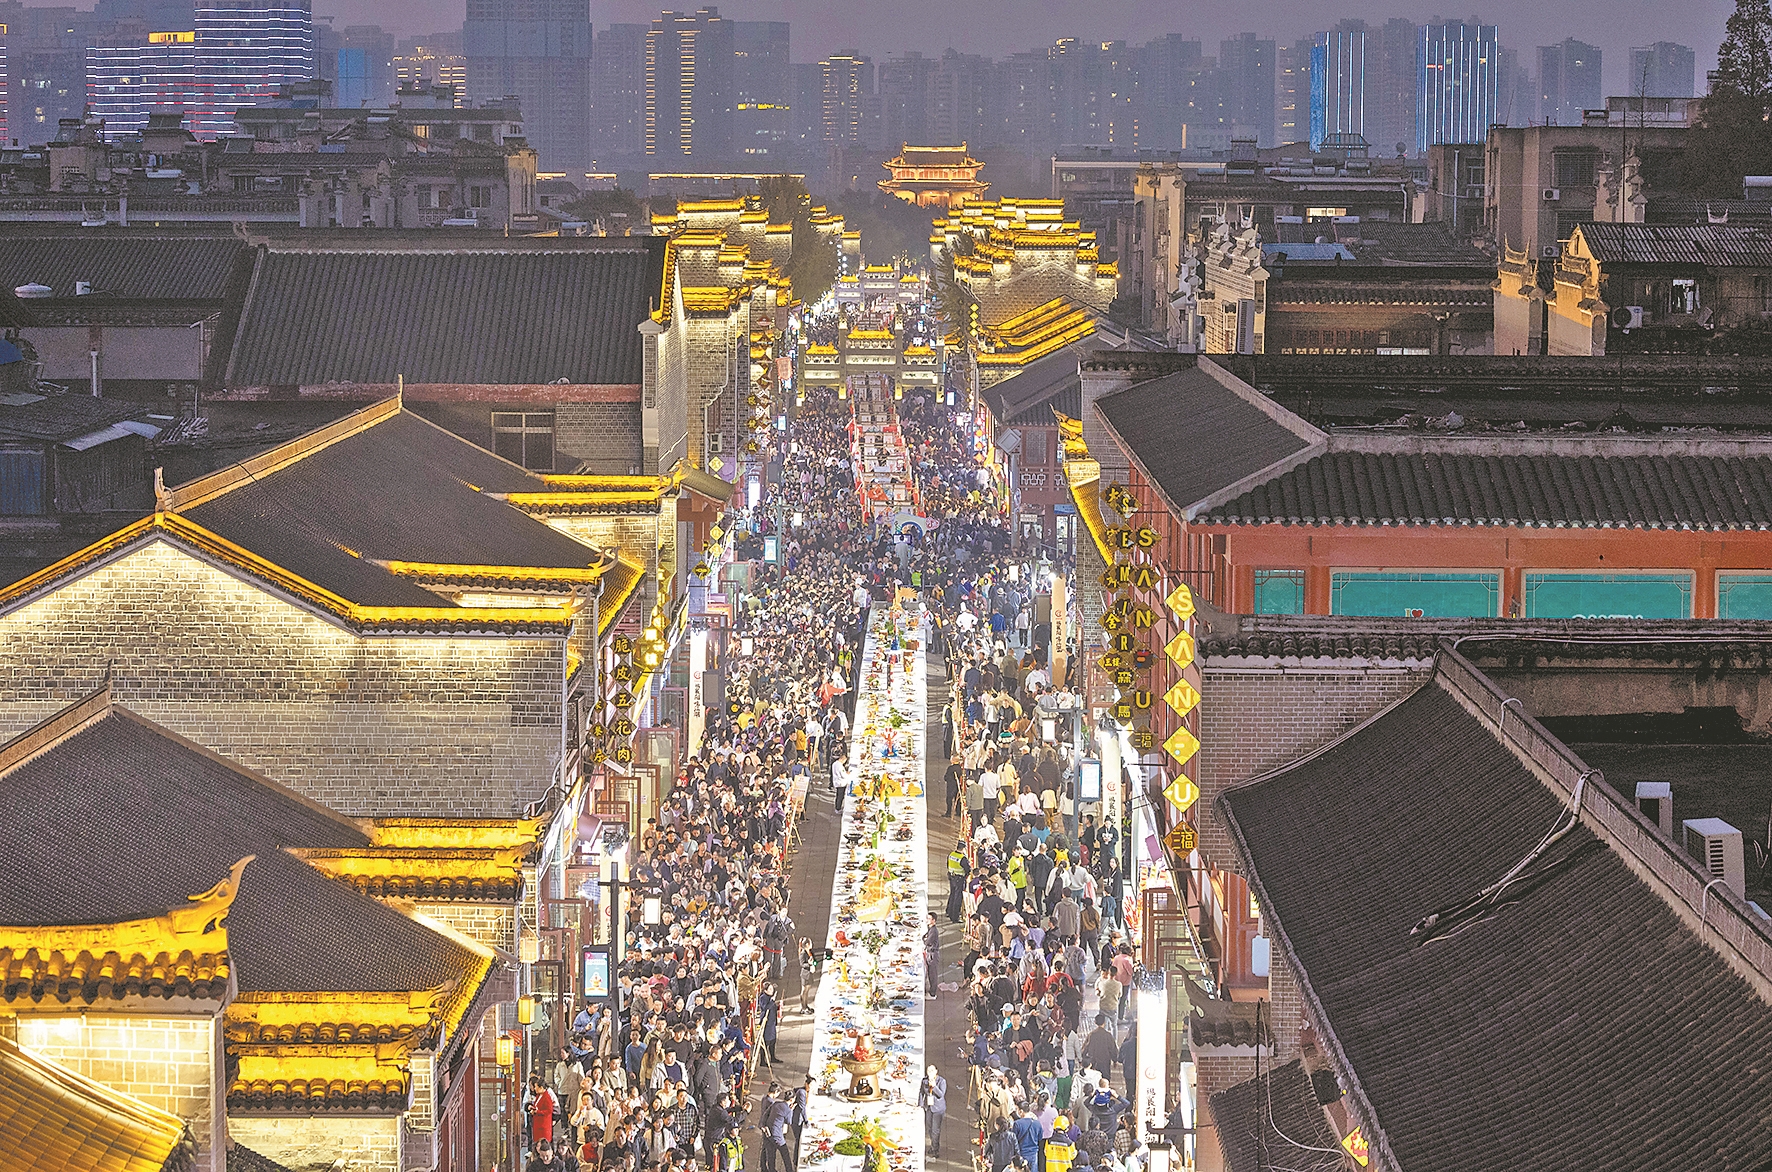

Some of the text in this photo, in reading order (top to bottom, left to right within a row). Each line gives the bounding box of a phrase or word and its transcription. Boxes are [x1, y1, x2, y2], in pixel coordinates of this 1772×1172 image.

[614, 639, 631, 762] 脆皮五花肉
[1172, 830, 1194, 850] 三福
